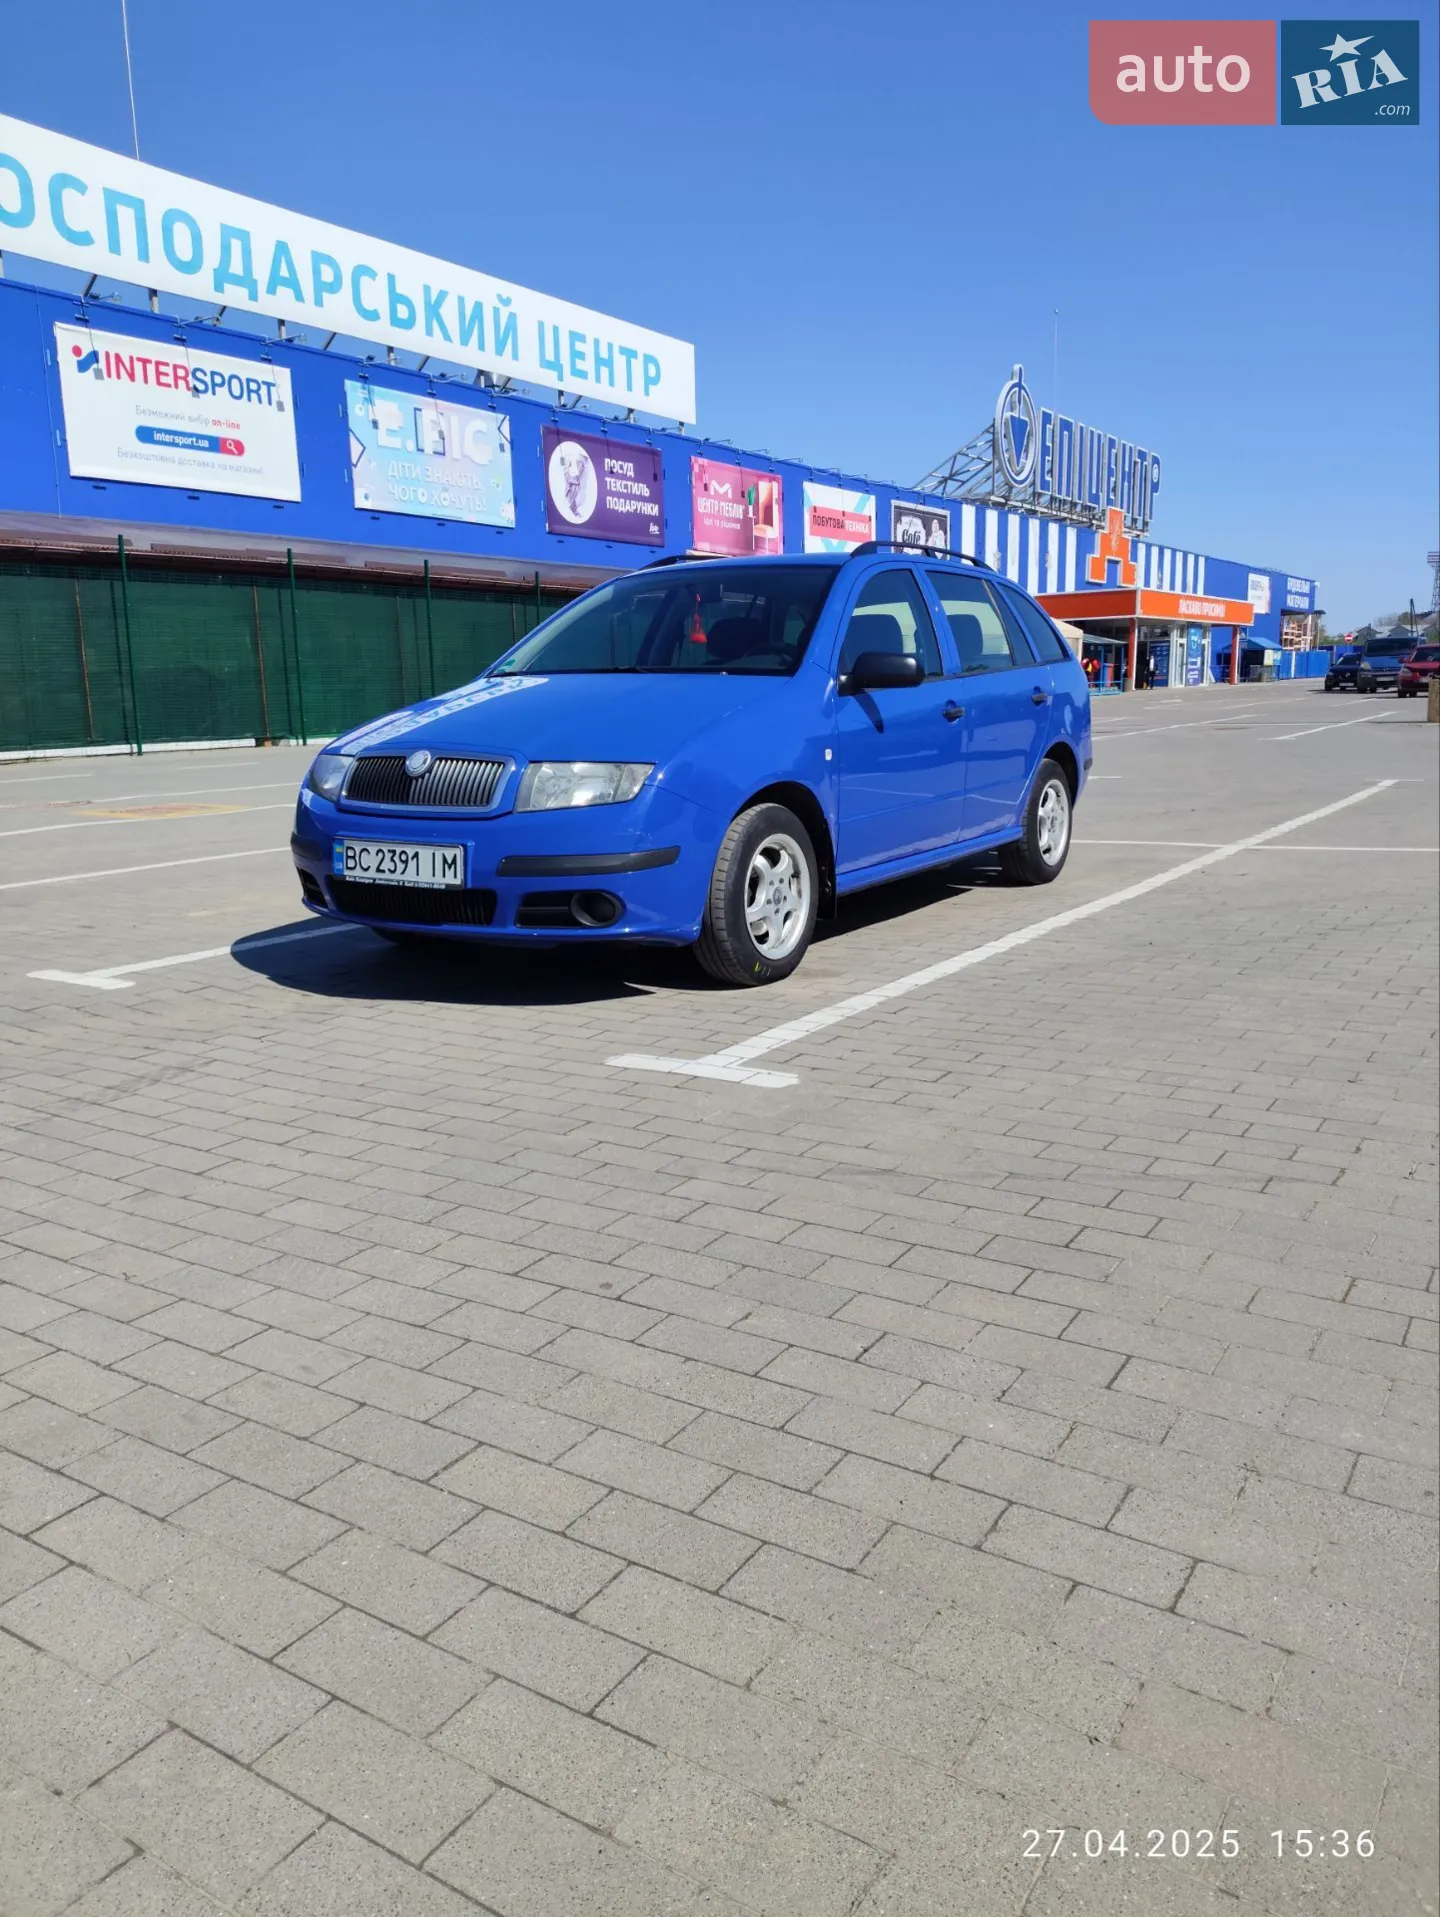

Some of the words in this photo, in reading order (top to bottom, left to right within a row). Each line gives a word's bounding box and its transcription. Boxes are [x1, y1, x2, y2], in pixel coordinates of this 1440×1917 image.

[537, 319, 662, 398] ЦЕНТР
[104, 350, 277, 407] INTERSPORT
[211, 418, 241, 430] on-line
[153, 430, 210, 449] intersport.ua
[388, 460, 421, 482] ДІТИ
[604, 457, 634, 478] ПОСУД
[1038, 407, 1161, 522] ЕПІЦЕНТР
[388, 484, 427, 504] ЧОГО
[604, 477, 650, 497] ТЕКСТИЛЬ
[606, 496, 659, 516] ПОДАРУНКИ
[812, 514, 845, 530] ПОБУТОВА
[375, 849, 420, 876] 2391
